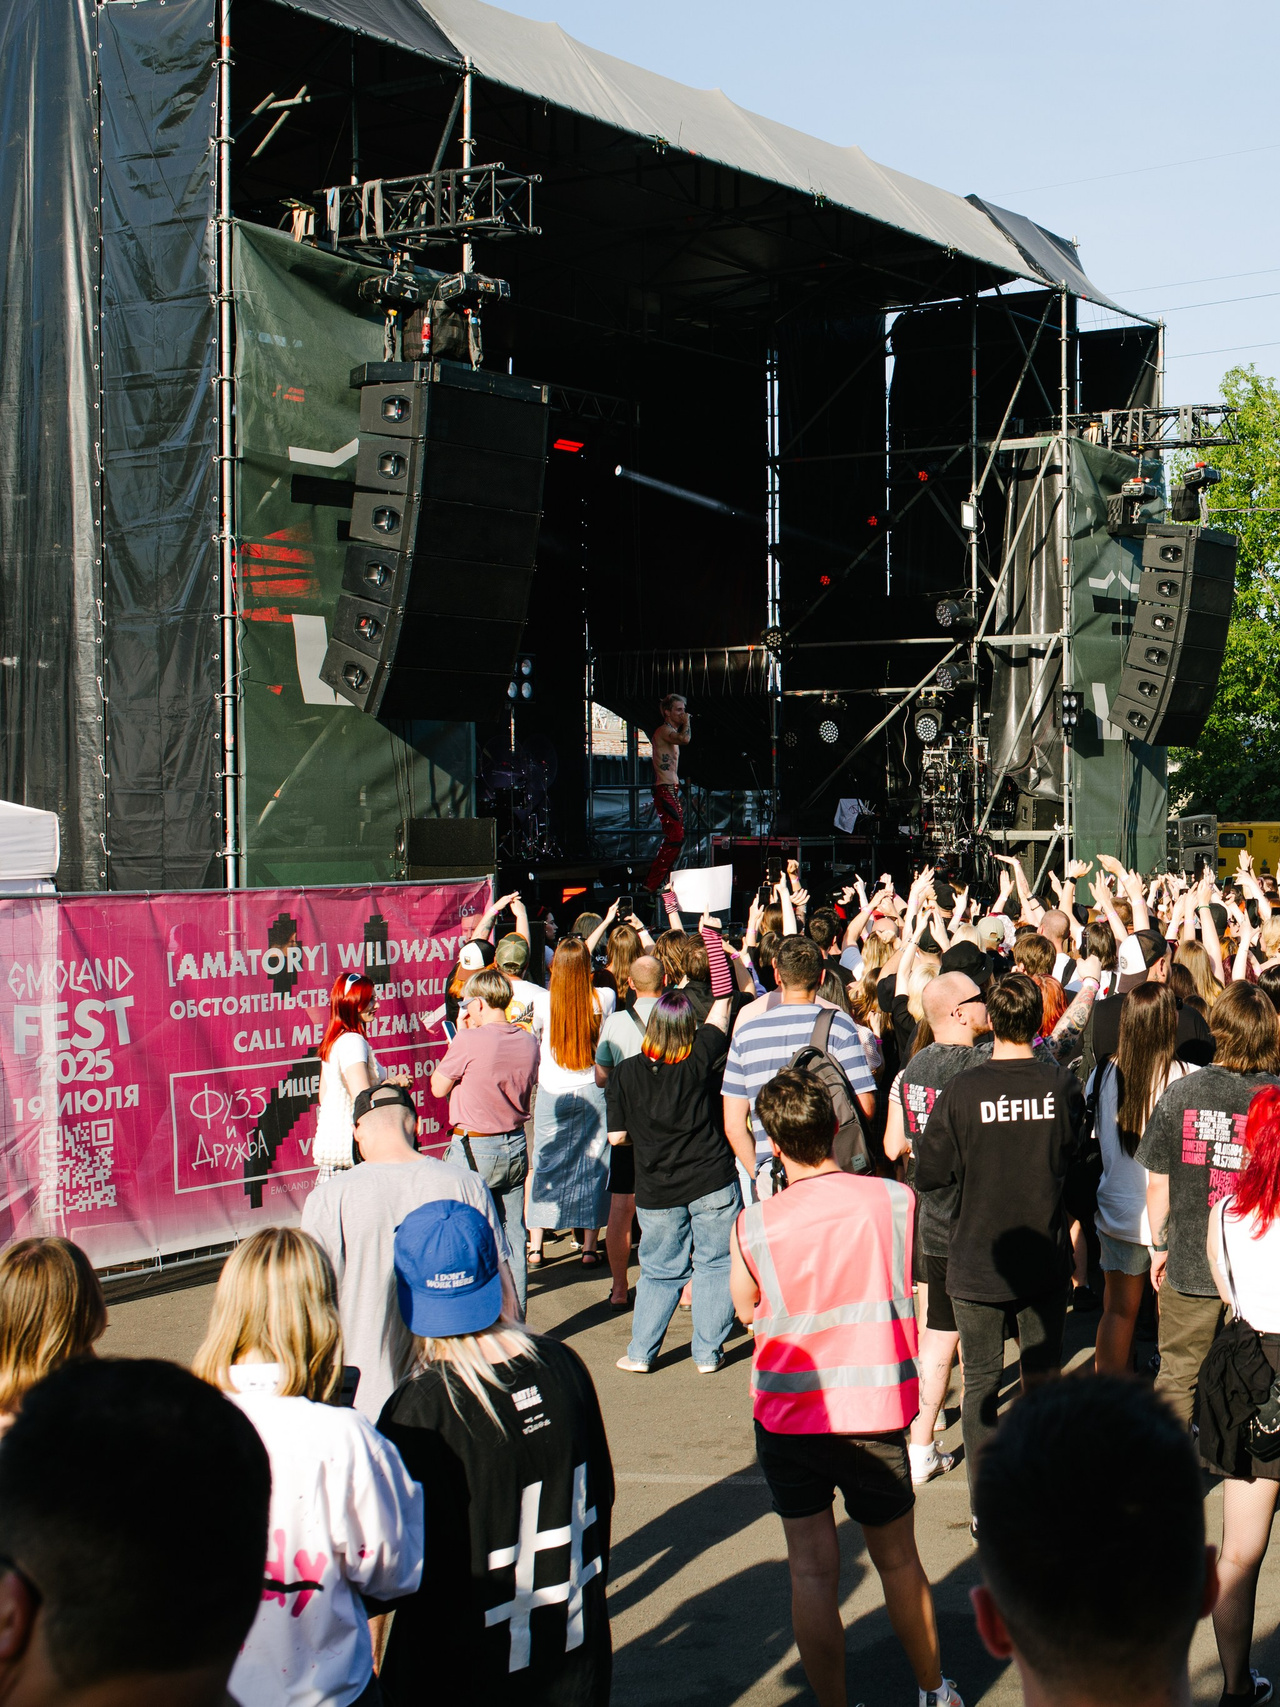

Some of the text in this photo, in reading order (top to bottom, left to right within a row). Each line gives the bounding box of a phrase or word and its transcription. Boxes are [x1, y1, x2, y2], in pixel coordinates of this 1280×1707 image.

[458, 904, 476, 918] 16+
[7, 956, 135, 1000] EMOLAND
[167, 942, 329, 988] [AMATORY]
[169, 988, 331, 1020] ОБСТОЯТЕЛЬСТВ
[13, 995, 135, 1055] FEST
[233, 1027, 286, 1053] CALL
[291, 1023, 324, 1047] ME
[35, 1048, 115, 1087] 2025
[12, 1083, 140, 1122] 19 ИЮЛЯ
[980, 1091, 1056, 1124] DÉFILÉ
[426, 1275, 475, 1289] WORK HERE
[434, 1271, 466, 1281] I DON'T
